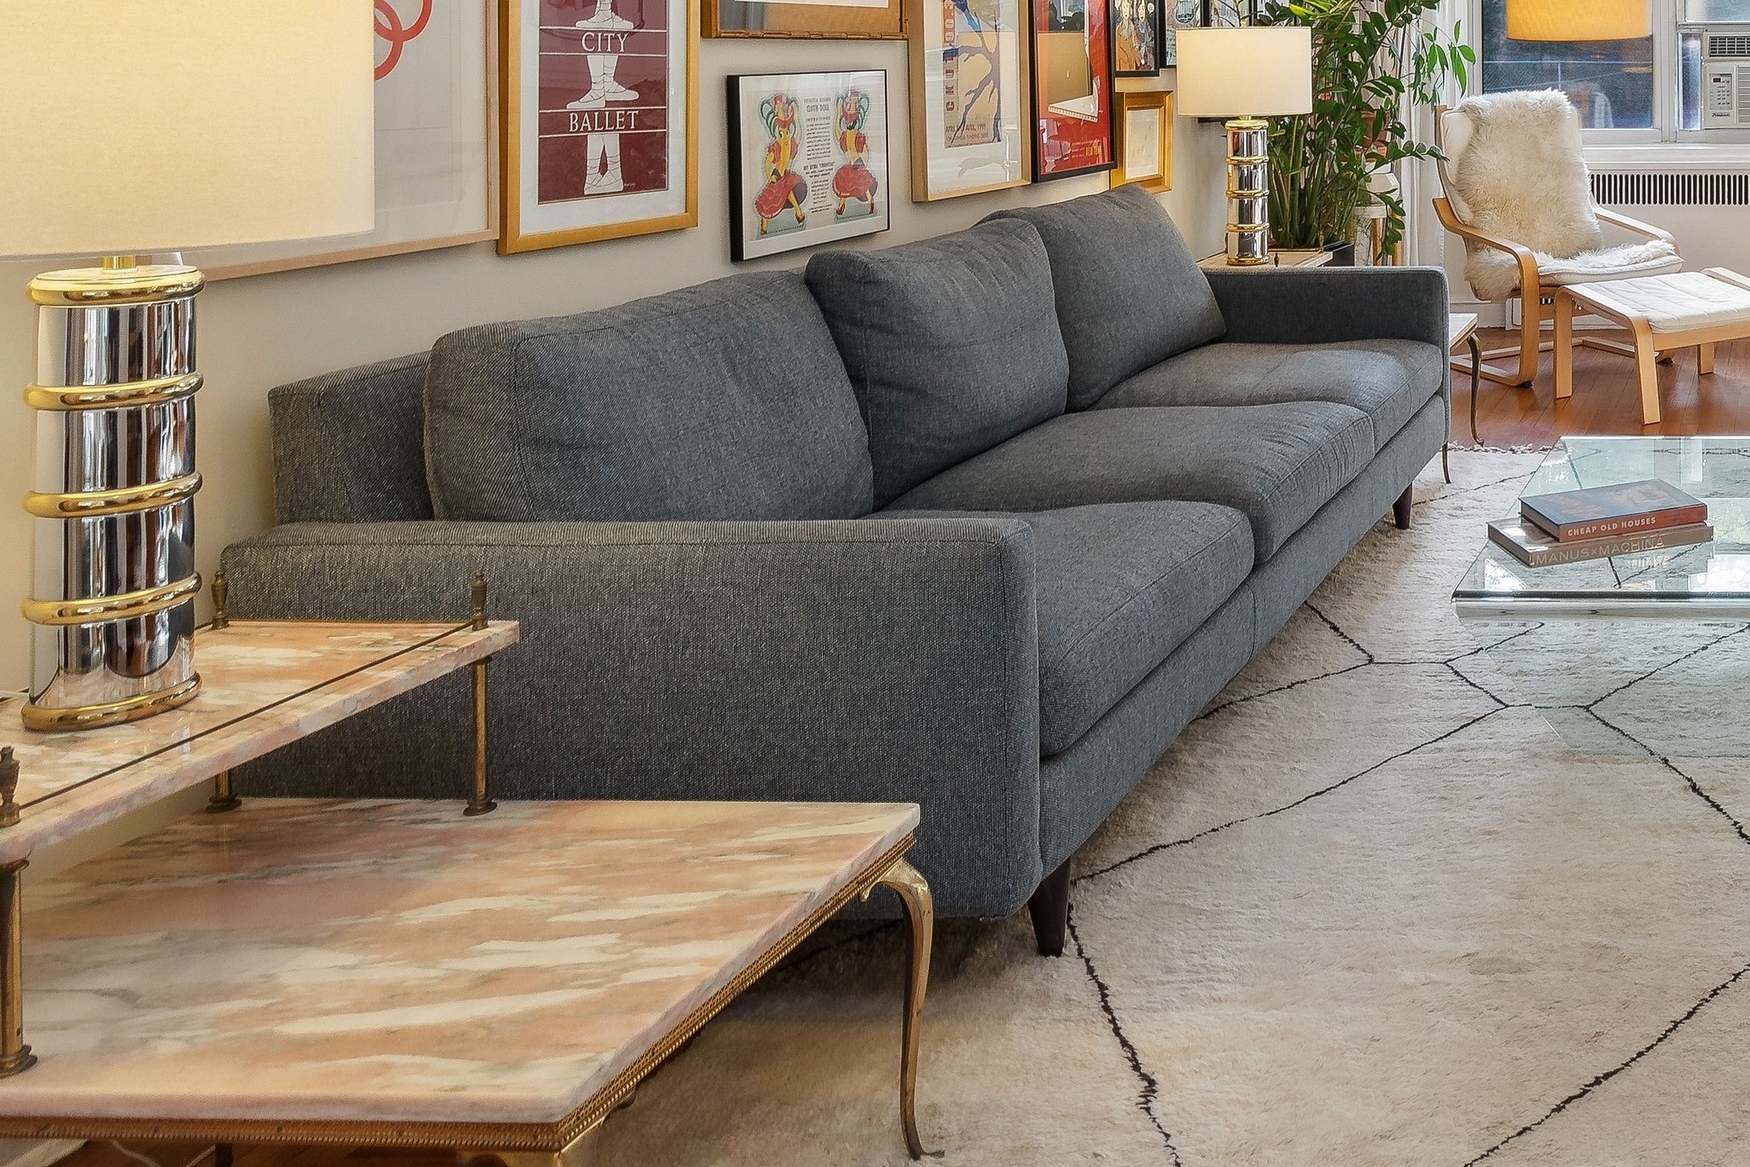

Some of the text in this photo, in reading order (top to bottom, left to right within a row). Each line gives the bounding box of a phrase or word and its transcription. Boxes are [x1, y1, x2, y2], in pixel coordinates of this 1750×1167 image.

[582, 31, 629, 54] CITY
[568, 109, 639, 133] BALLET
[1567, 525, 1598, 537] CHEAP
[1600, 523, 1618, 532] OLD
[1621, 516, 1657, 529] HOUSES
